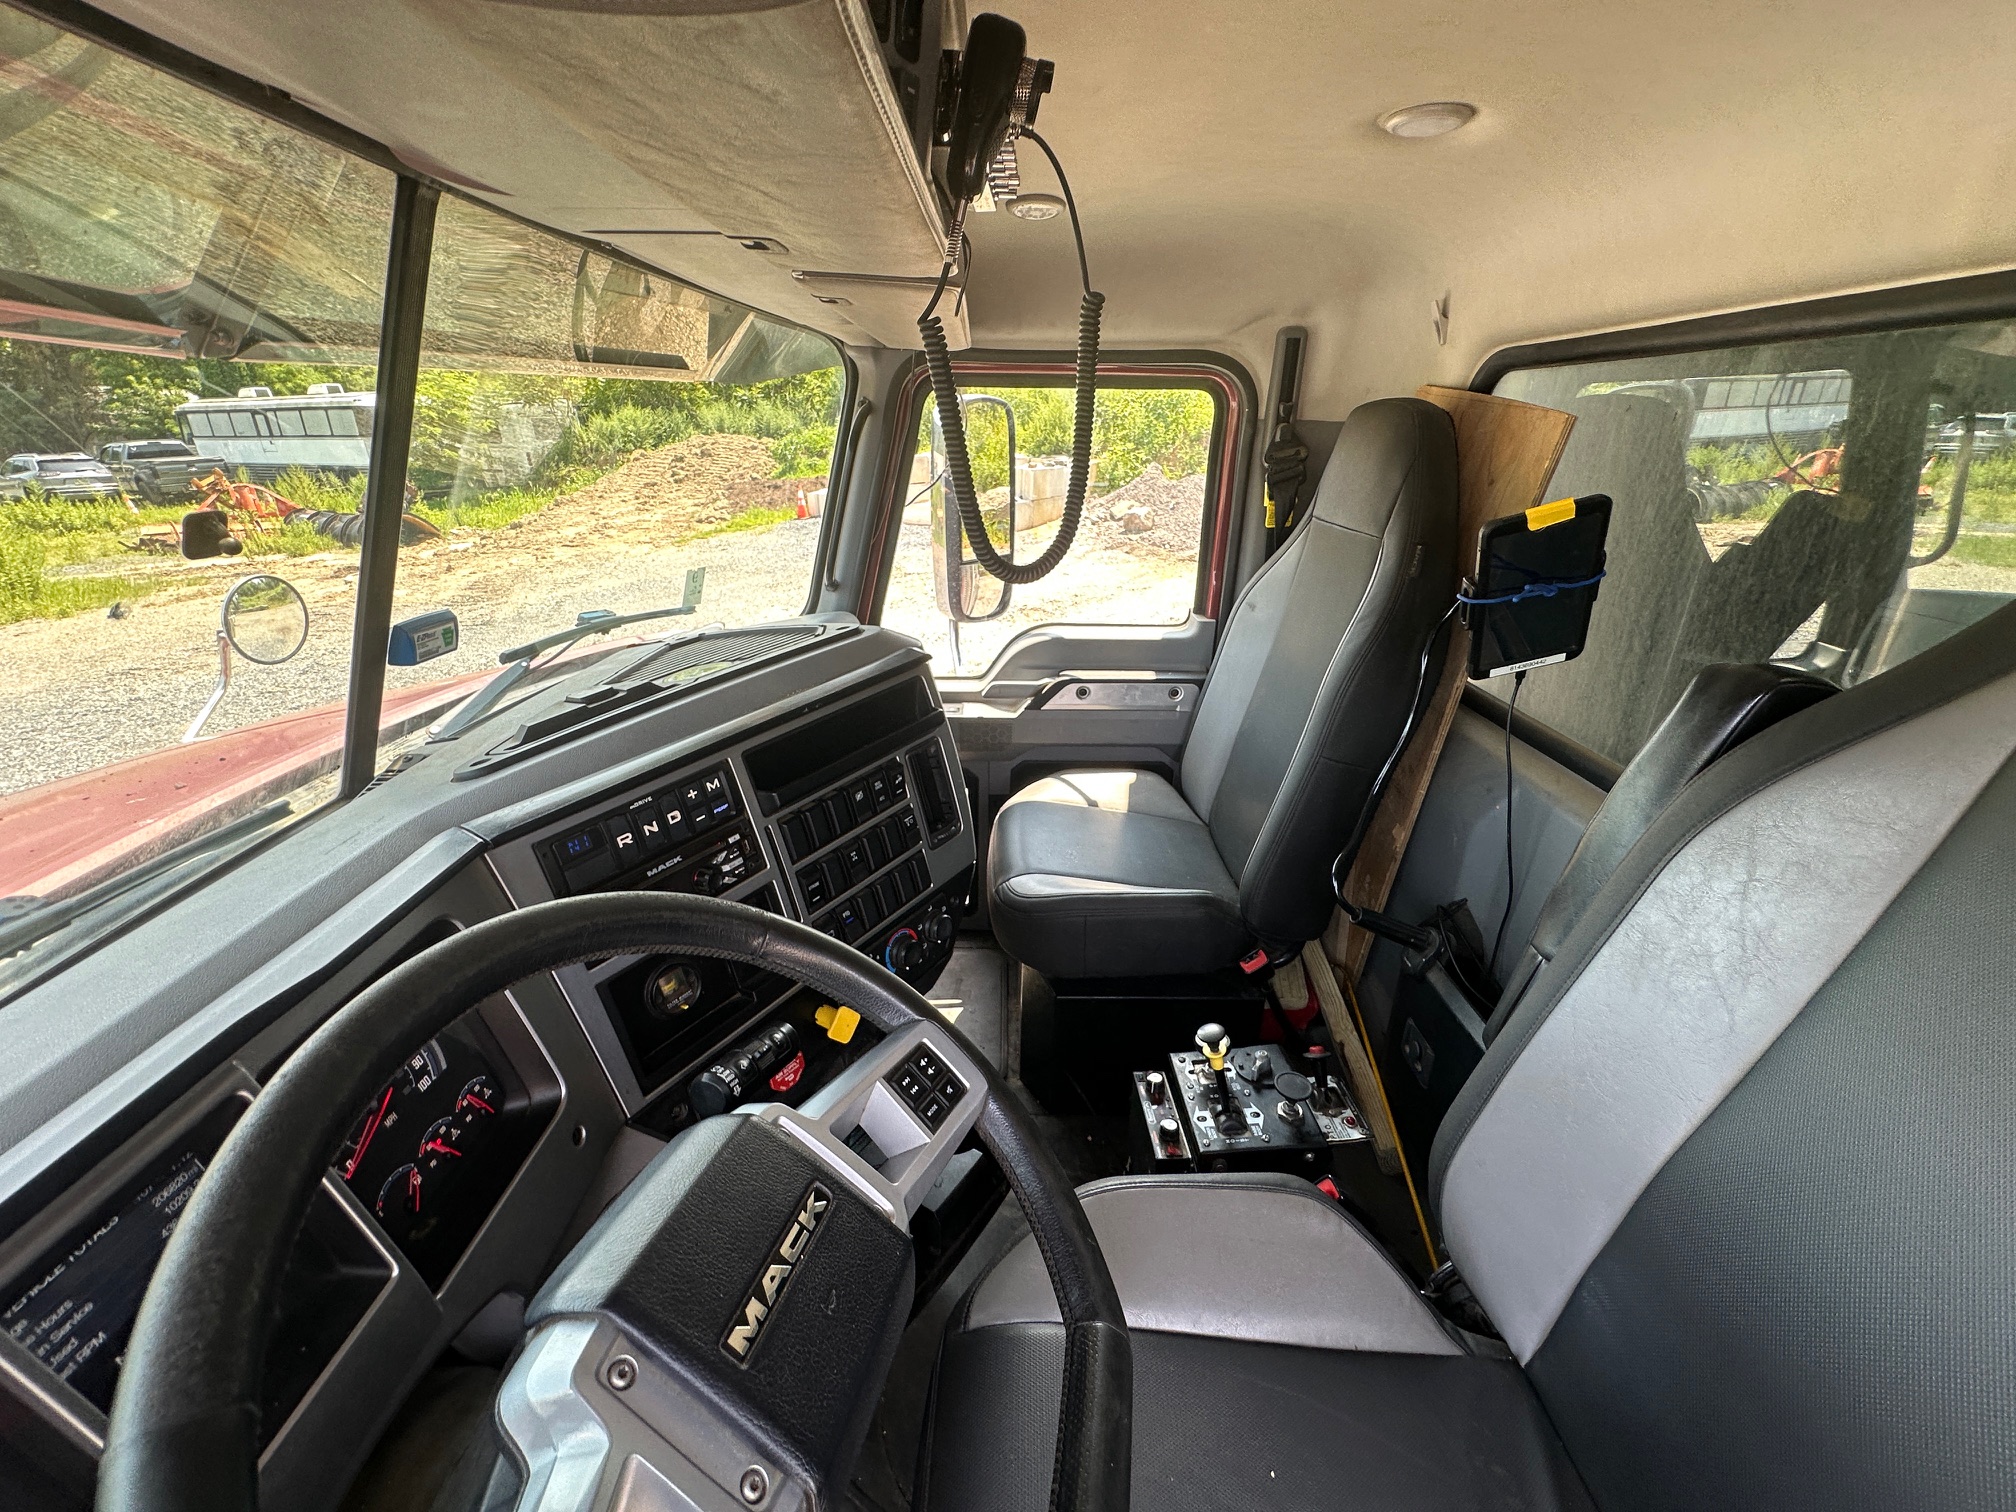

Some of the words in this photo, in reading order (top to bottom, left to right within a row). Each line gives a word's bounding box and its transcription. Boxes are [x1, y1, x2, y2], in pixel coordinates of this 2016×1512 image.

[705, 778, 720, 793] M
[666, 809, 682, 825] D
[643, 820, 659, 836] N
[616, 832, 634, 848] R
[646, 855, 683, 877] MACK
[411, 1054, 424, 1070] 90
[417, 1075, 432, 1093] 100
[927, 1103, 938, 1117] MODE
[384, 1111, 398, 1128] MPH
[727, 1191, 827, 1355] MACK
[50, 1301, 94, 1343] Service
